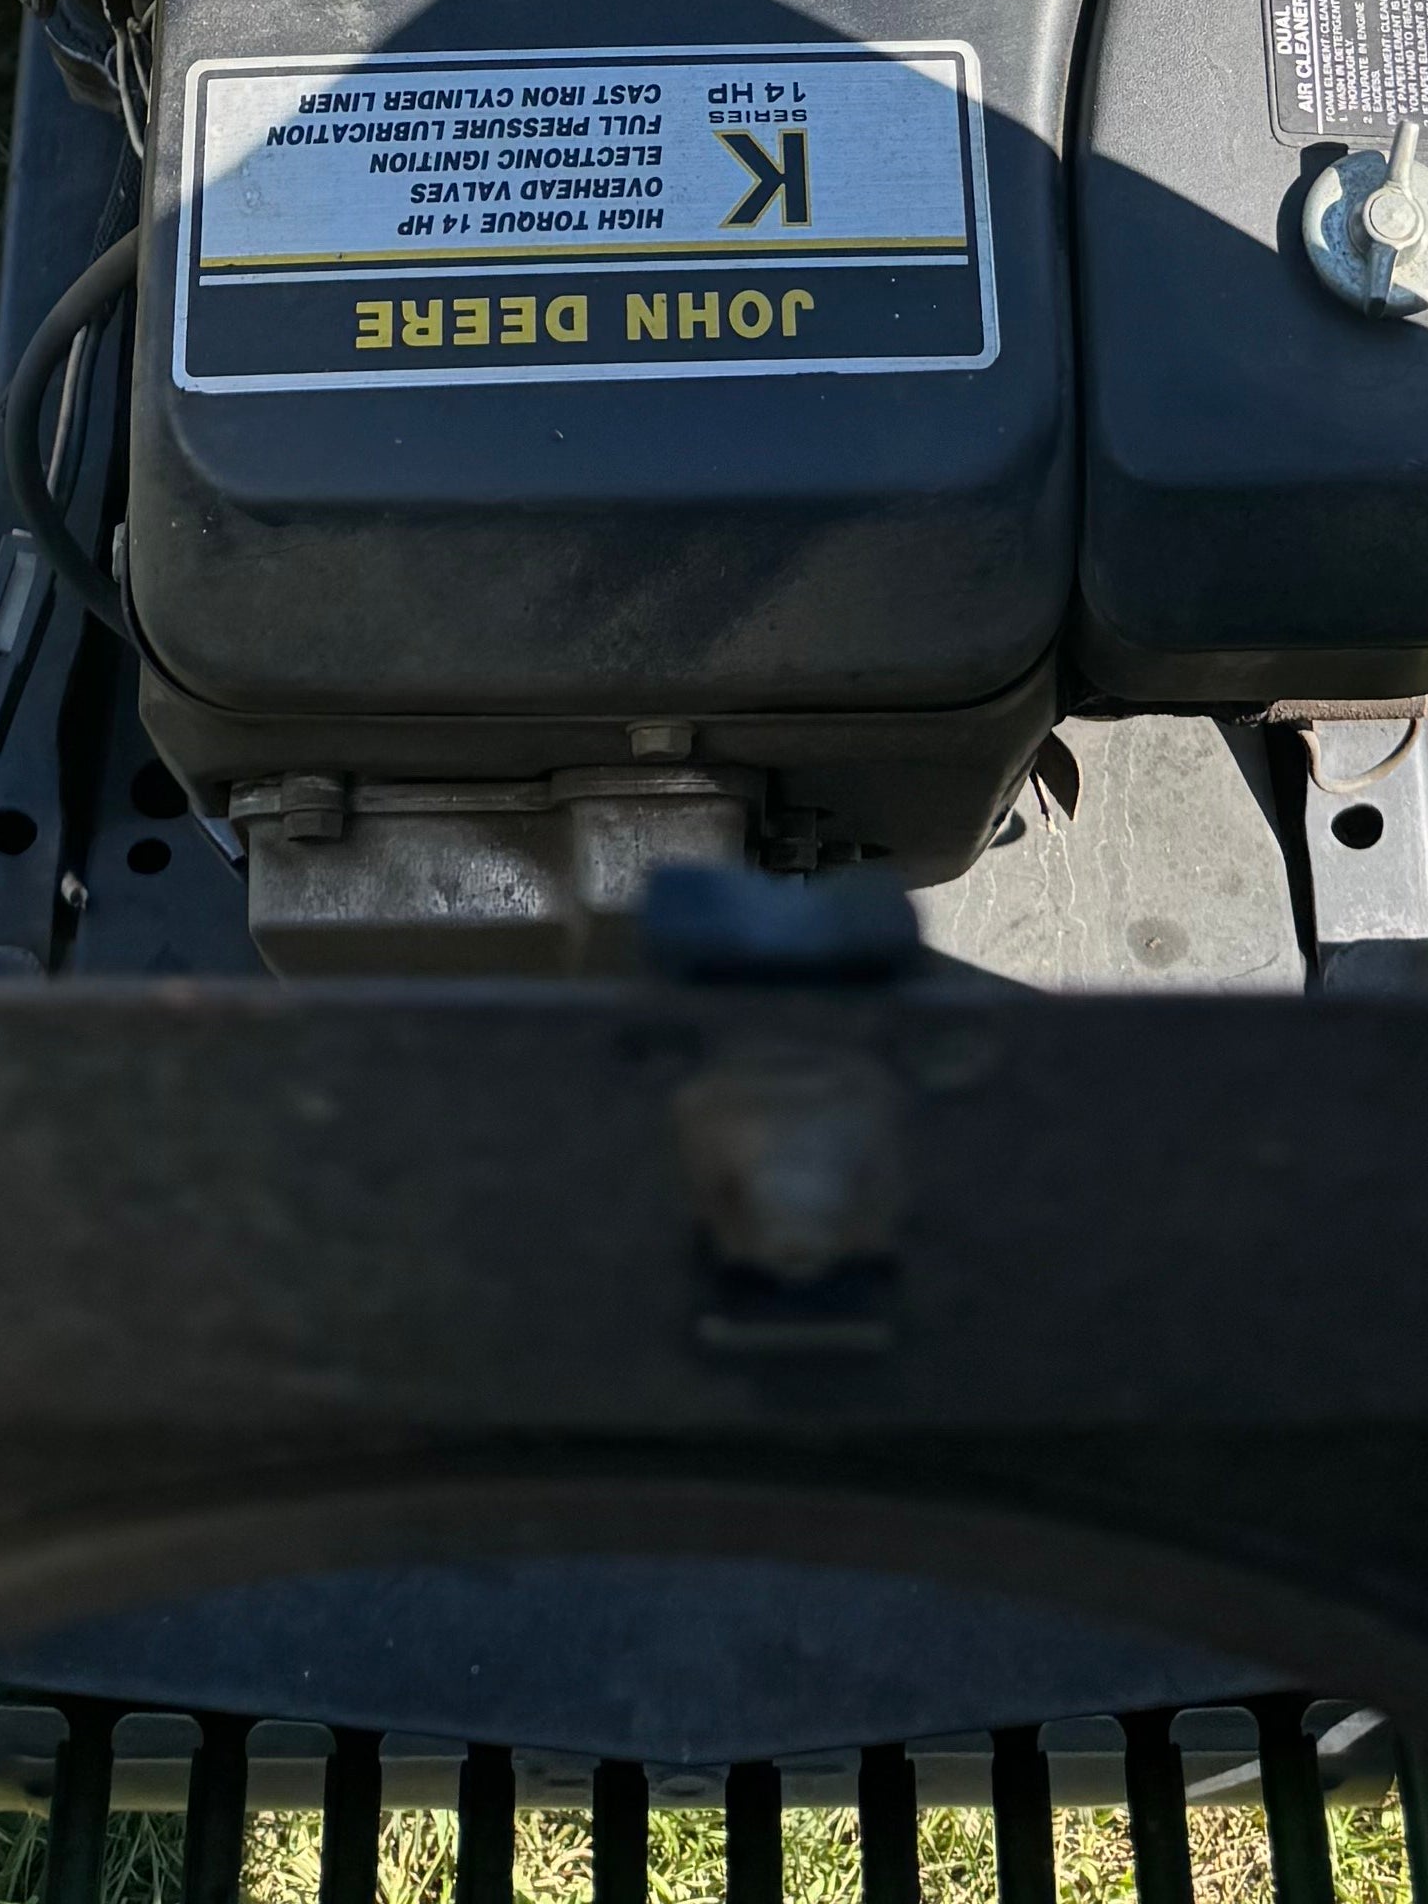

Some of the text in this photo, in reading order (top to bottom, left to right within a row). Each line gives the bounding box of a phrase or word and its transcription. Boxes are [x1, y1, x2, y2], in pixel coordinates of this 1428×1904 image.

[1274, 5, 1292, 54] DUAL
[1330, 0, 1344, 61] DETERGENT
[1355, 2, 1367, 40] ENGINE
[1391, 14, 1404, 63] ELEMENT
[1404, 32, 1414, 46] TO
[299, 84, 662, 113] CAST IRON CYLINDER LINER
[709, 81, 807, 106] 14 HP
[1297, 83, 1314, 113] AIR
[1336, 78, 1347, 110] WASH
[1395, 66, 1407, 101] PAPER
[1408, 83, 1419, 112] YOUR
[709, 109, 808, 125] SERIES
[1324, 90, 1336, 121] FOAM
[1385, 90, 1397, 125] PAPER
[266, 115, 662, 146] FULL PRESSURE LUBRICATION
[370, 146, 662, 173] ELECTRONIC IGNITION
[410, 177, 662, 204] OVERHEAD VALVES
[714, 127, 813, 229] K
[397, 208, 664, 236] HIGH TORQUE 14 HP
[354, 287, 816, 350] JOHN DEERE
